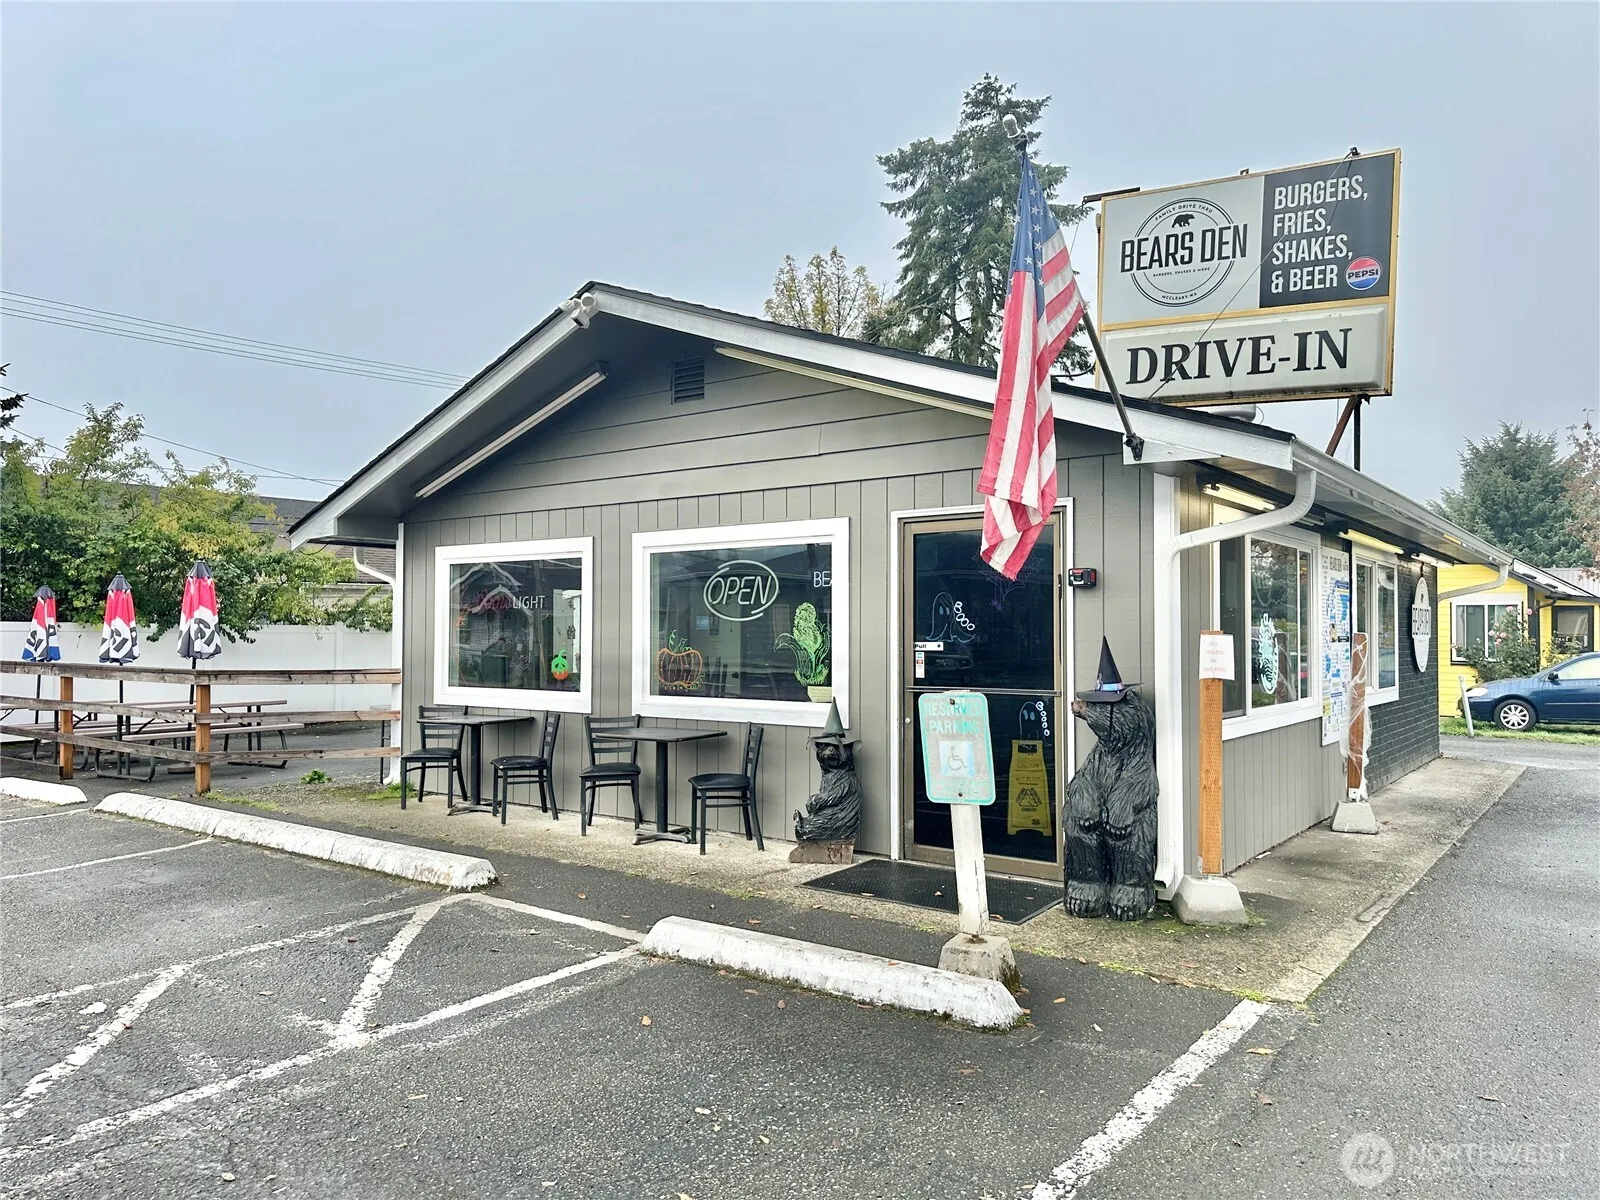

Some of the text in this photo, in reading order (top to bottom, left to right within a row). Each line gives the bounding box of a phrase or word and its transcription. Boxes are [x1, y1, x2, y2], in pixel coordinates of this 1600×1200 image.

[1274, 175, 1368, 210] BURGERS,
[1155, 206, 1176, 221] FAMILY
[1198, 204, 1213, 213] THRU
[1272, 208, 1332, 237] FRIES,
[1120, 223, 1248, 273] BEARS DEN
[1272, 234, 1353, 265] SHAKES,
[1271, 264, 1338, 294] & BEER
[1347, 269, 1379, 279] PEPSI
[1125, 327, 1353, 385] DRIVE-IN
[512, 595, 546, 609] LIGHT
[707, 575, 773, 605] OPEN
